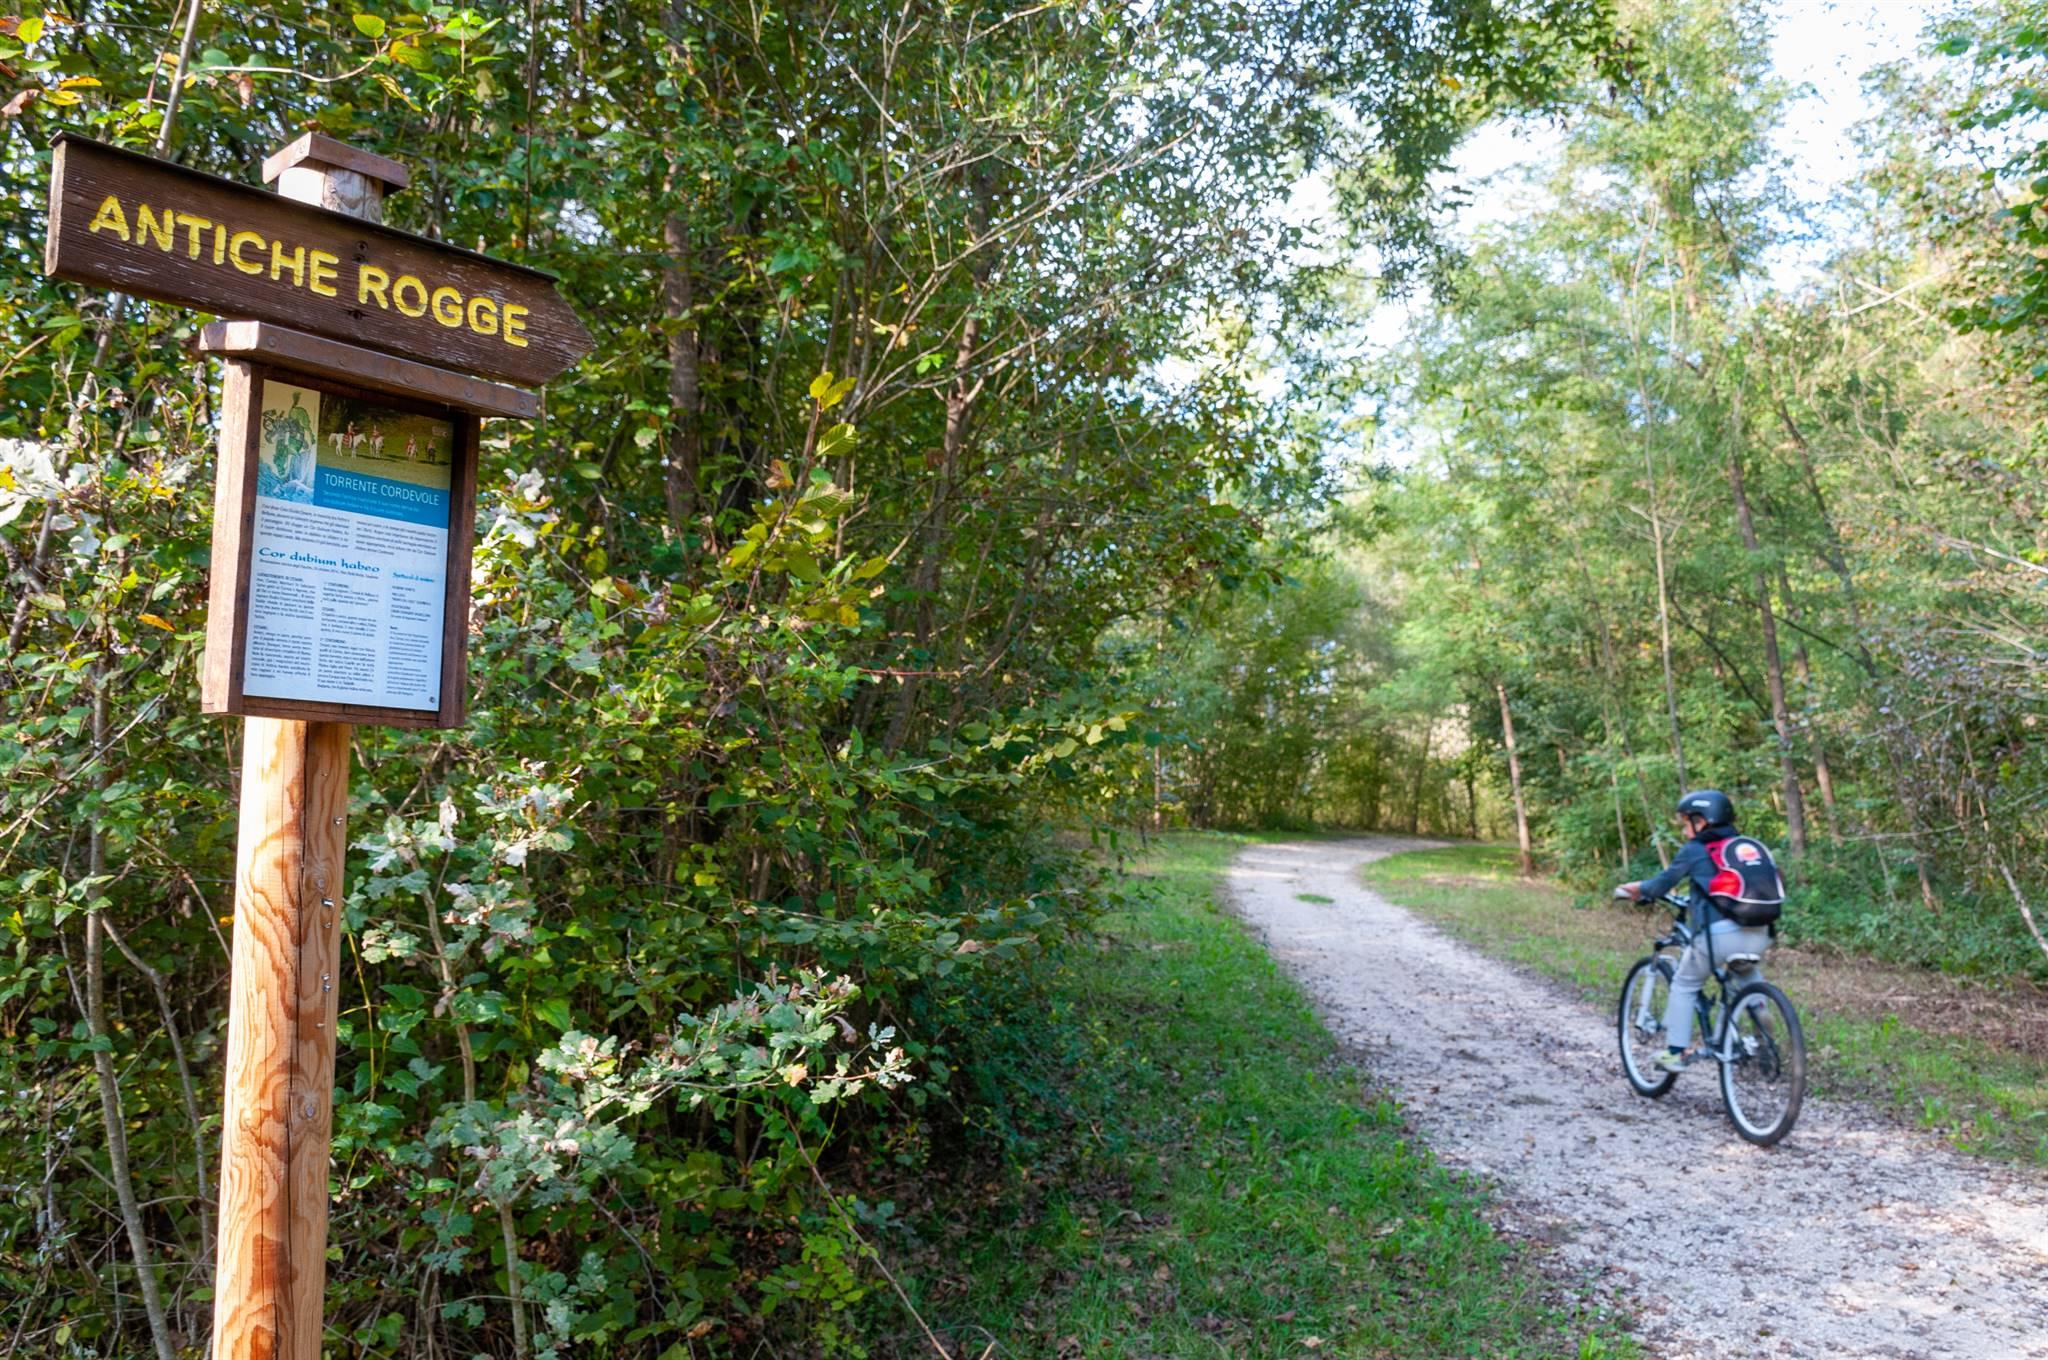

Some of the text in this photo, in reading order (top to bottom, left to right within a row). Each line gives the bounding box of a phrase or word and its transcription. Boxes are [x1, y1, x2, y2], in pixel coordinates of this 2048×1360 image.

[89, 195, 529, 348] ANTICHE ROGGE
[324, 473, 378, 495] TORRENTE
[380, 484, 440, 506] CORDEVOLE
[258, 547, 286, 559] Cor
[290, 551, 337, 567] dubium
